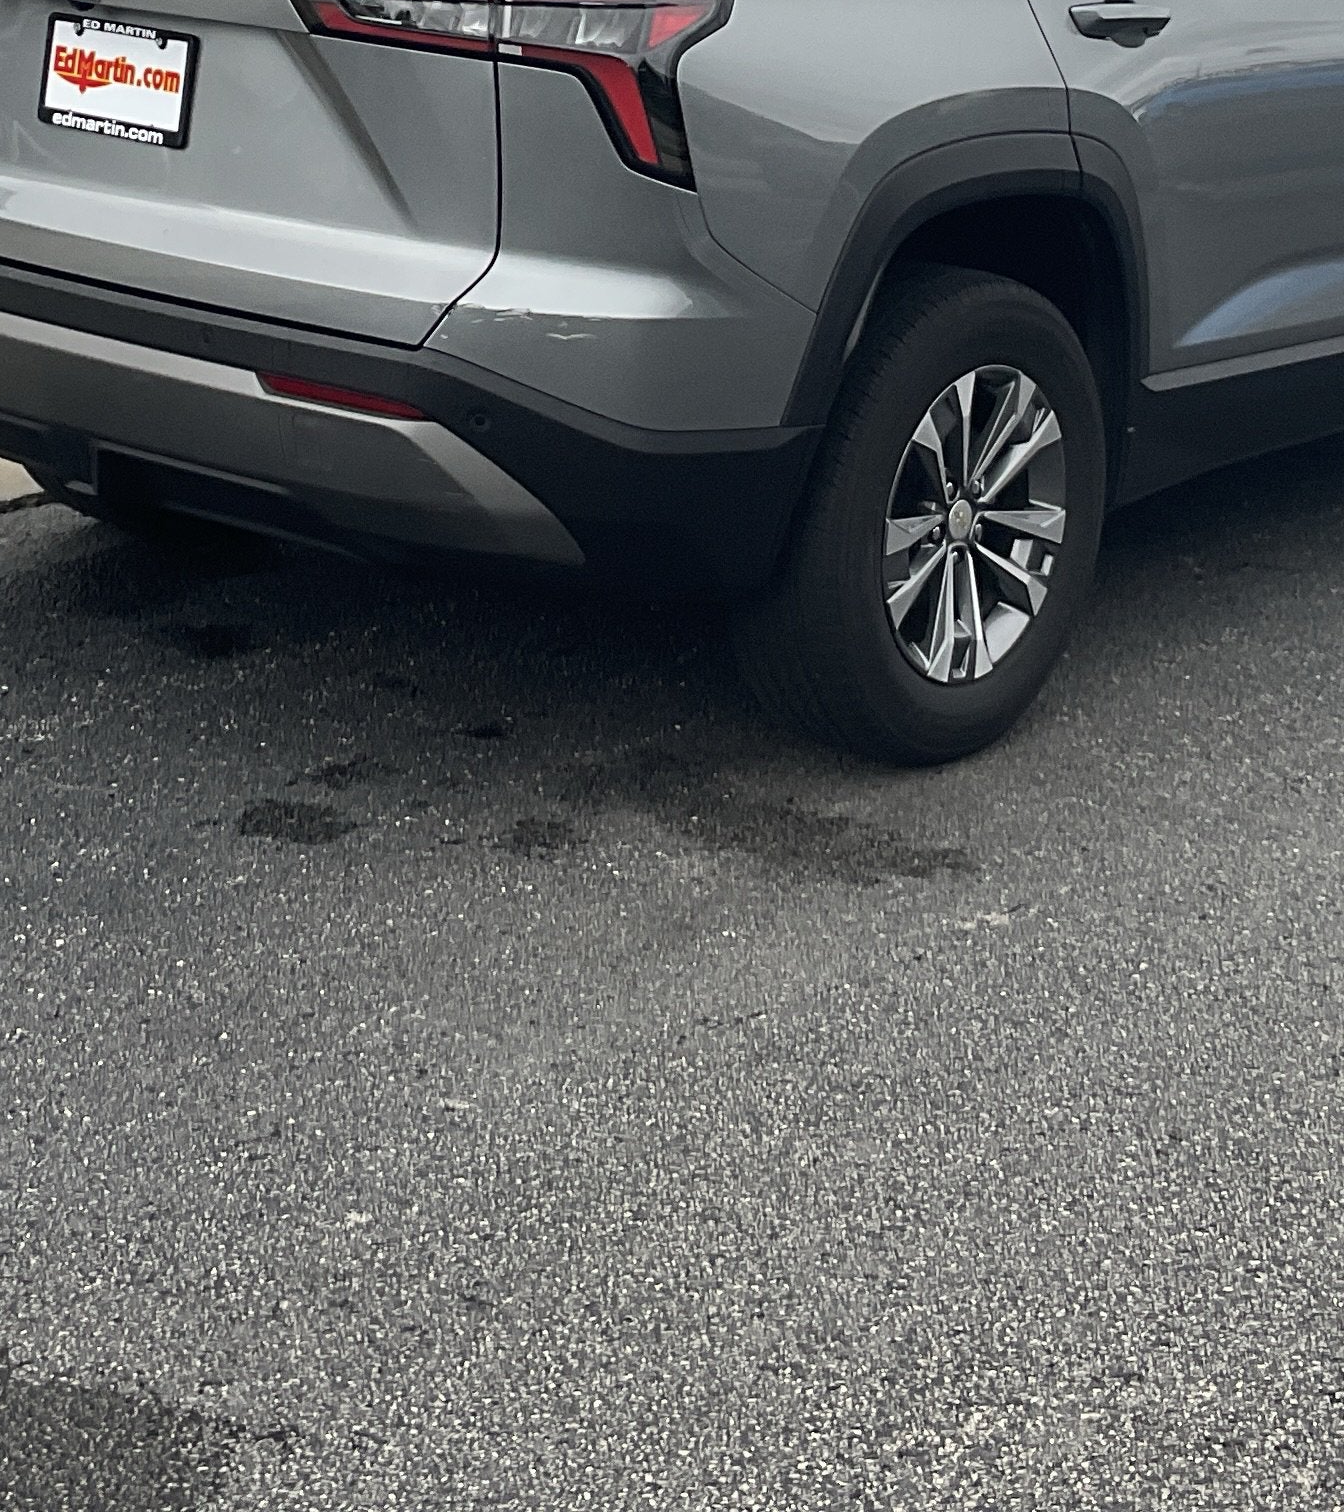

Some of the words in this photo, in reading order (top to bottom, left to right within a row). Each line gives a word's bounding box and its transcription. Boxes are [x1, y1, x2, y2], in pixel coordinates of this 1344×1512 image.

[82, 18, 101, 30] ED
[103, 22, 157, 40] MARTIN
[52, 111, 164, 145] edmartin.com
